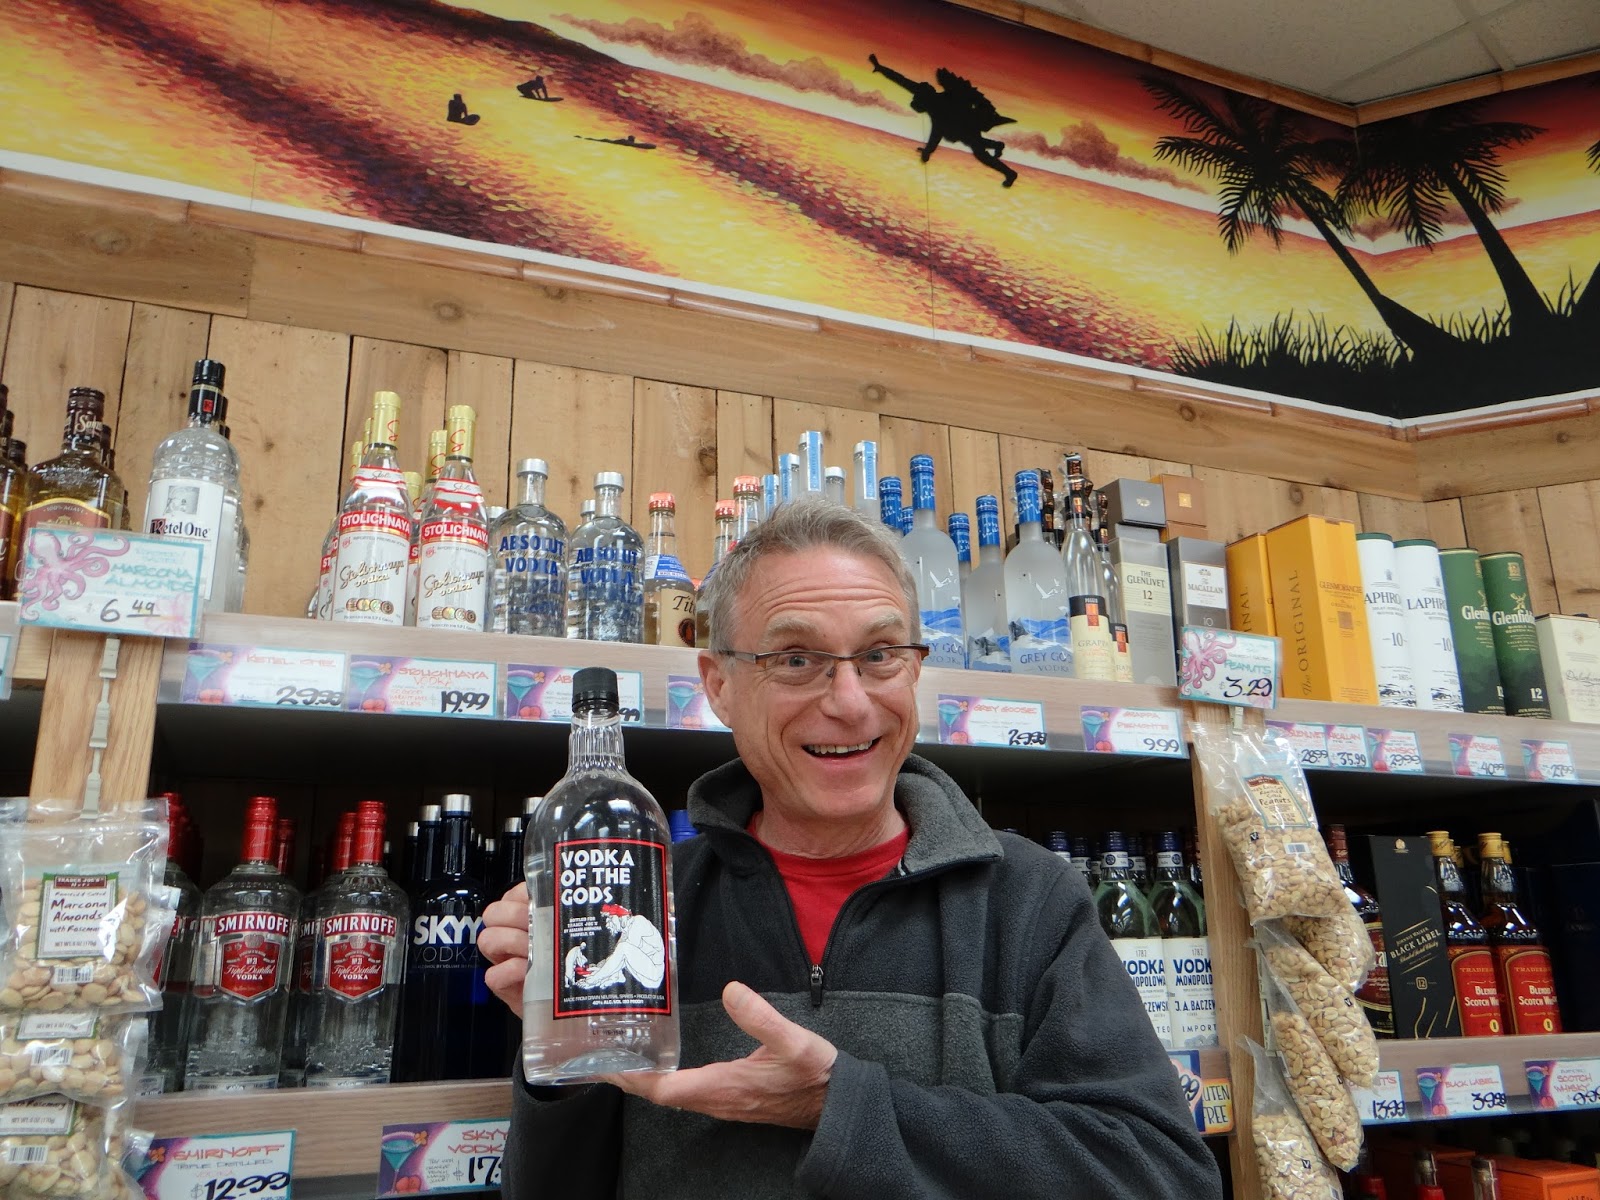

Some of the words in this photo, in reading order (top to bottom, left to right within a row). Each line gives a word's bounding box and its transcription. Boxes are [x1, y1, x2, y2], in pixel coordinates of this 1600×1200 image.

[151, 518, 183, 536] Ketel
[185, 522, 208, 538] One
[342, 514, 410, 533] STOLICHNAYA
[424, 524, 488, 543] STOLICHNAYA
[500, 535, 565, 555] ABSOLUT
[1127, 575, 1165, 588] GLENLIVET
[1188, 583, 1224, 594] MACALLAN
[1143, 590, 1153, 600] 12
[1289, 569, 1309, 672] ORIGINAL
[1020, 653, 1047, 664] GREY
[1224, 660, 1272, 675] PEANUTS
[1223, 676, 1272, 697] 3.29
[1530, 688, 1543, 699] 12
[441, 690, 490, 713] 19.99
[1000, 706, 1037, 714] GOOSE
[1143, 737, 1179, 752] 9.99
[1338, 752, 1366, 766] 35.99
[1259, 798, 1291, 806] Peanuts
[561, 849, 635, 868] VODKA
[561, 868, 587, 887] OF
[592, 868, 631, 885] THE
[561, 886, 613, 906] GODS
[51, 898, 107, 910] Marcona
[53, 910, 103, 922] Almonds
[218, 914, 289, 933] SMIRNOFF
[325, 917, 395, 934] SMIRNOFF
[413, 915, 484, 945] SKYY
[1390, 942, 1415, 959] BLACK
[1417, 929, 1441, 945] LABEL
[413, 947, 480, 962] VODKA
[1418, 979, 1426, 988] 12
[1465, 997, 1489, 1006] SCOTCH
[1519, 996, 1543, 1005] SCOTCH
[1469, 1078, 1499, 1086] LABEL
[1557, 1073, 1592, 1082] SCOTCH
[1554, 1083, 1591, 1092] WHISKY
[462, 1128, 508, 1141] SKYY
[174, 1144, 285, 1161] SMIRNOFF
[174, 1162, 212, 1170] TRIPLE
[216, 1158, 273, 1168] DISTILLED
[468, 1156, 501, 1186] 17.
